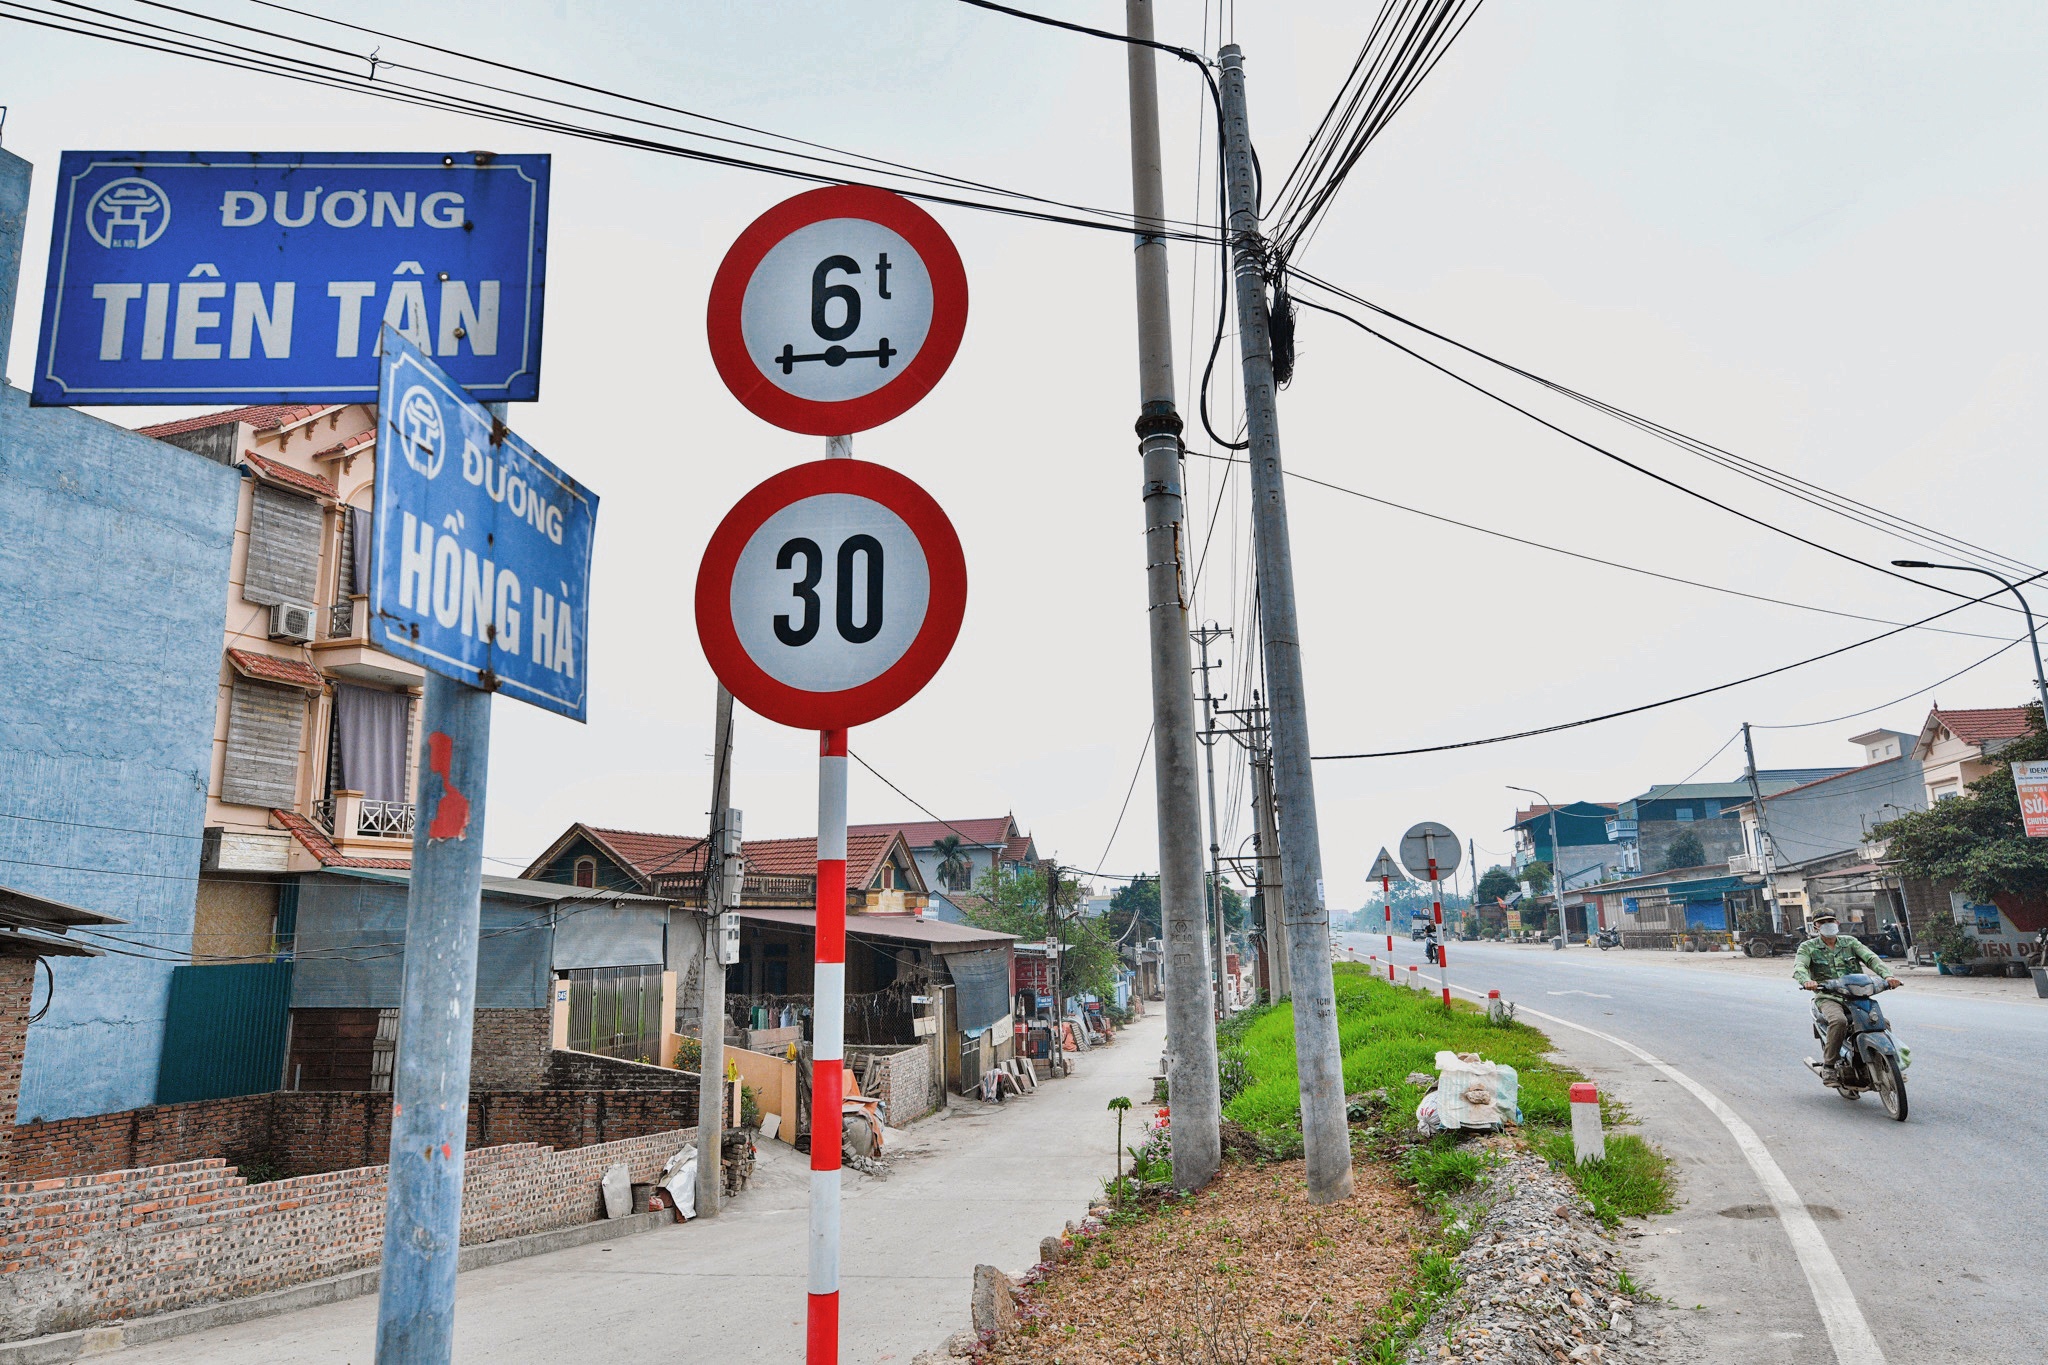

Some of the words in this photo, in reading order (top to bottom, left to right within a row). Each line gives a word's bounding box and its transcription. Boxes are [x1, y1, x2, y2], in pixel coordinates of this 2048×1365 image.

[93, 263, 295, 361] TIÊN
[327, 261, 500, 358] TÂN
[462, 438, 563, 545] ĐƯỜNG
[399, 510, 522, 656] HỒNG
[532, 580, 575, 680] HÀ
[773, 534, 884, 647] 30
